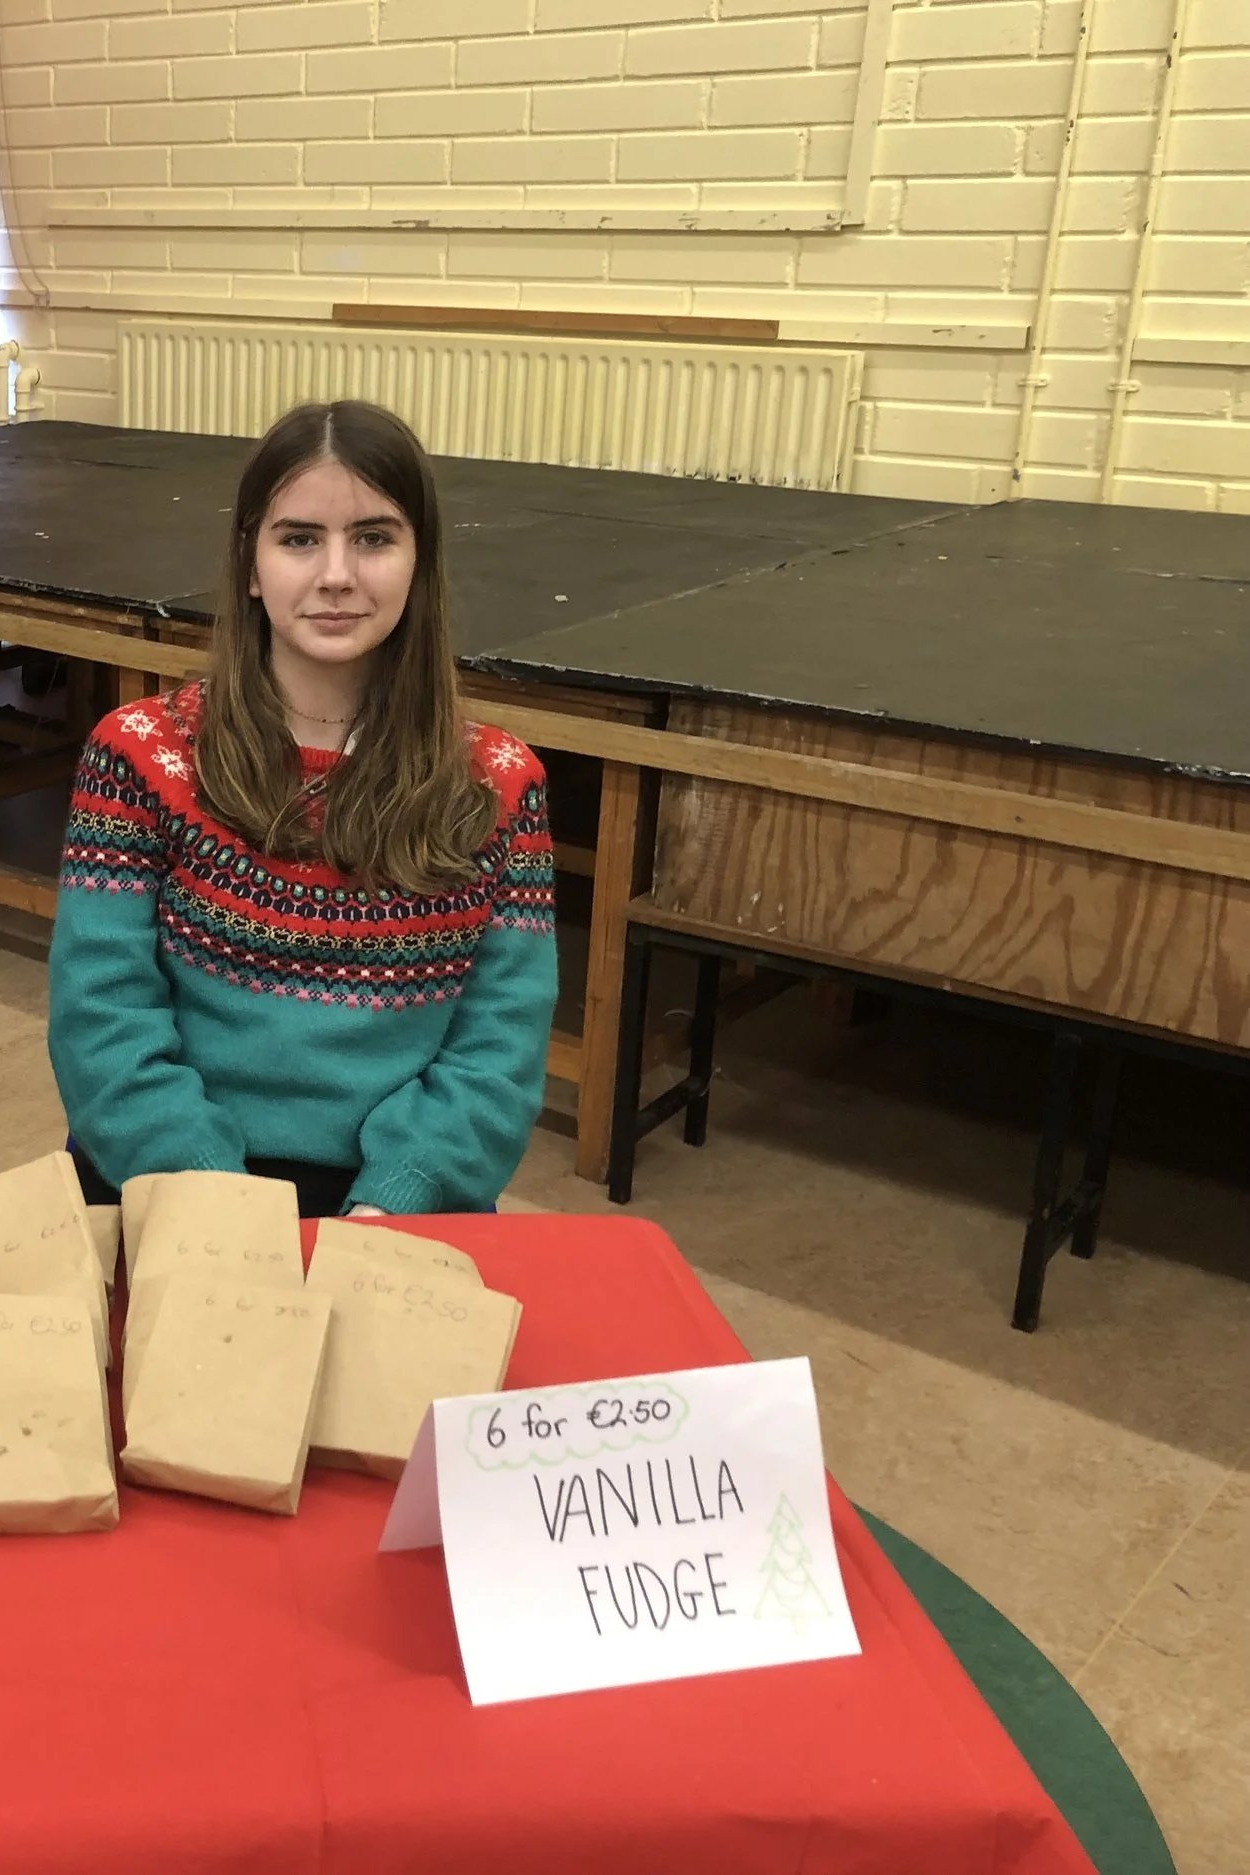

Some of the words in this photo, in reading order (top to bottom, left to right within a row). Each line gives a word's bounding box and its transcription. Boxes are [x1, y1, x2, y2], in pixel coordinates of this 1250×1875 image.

[486, 1407, 506, 1448] 6
[521, 1402, 568, 1439] for
[586, 1398, 672, 1429] €2.50
[533, 1455, 744, 1542] VANILLA
[578, 1552, 736, 1635] FUDGE
